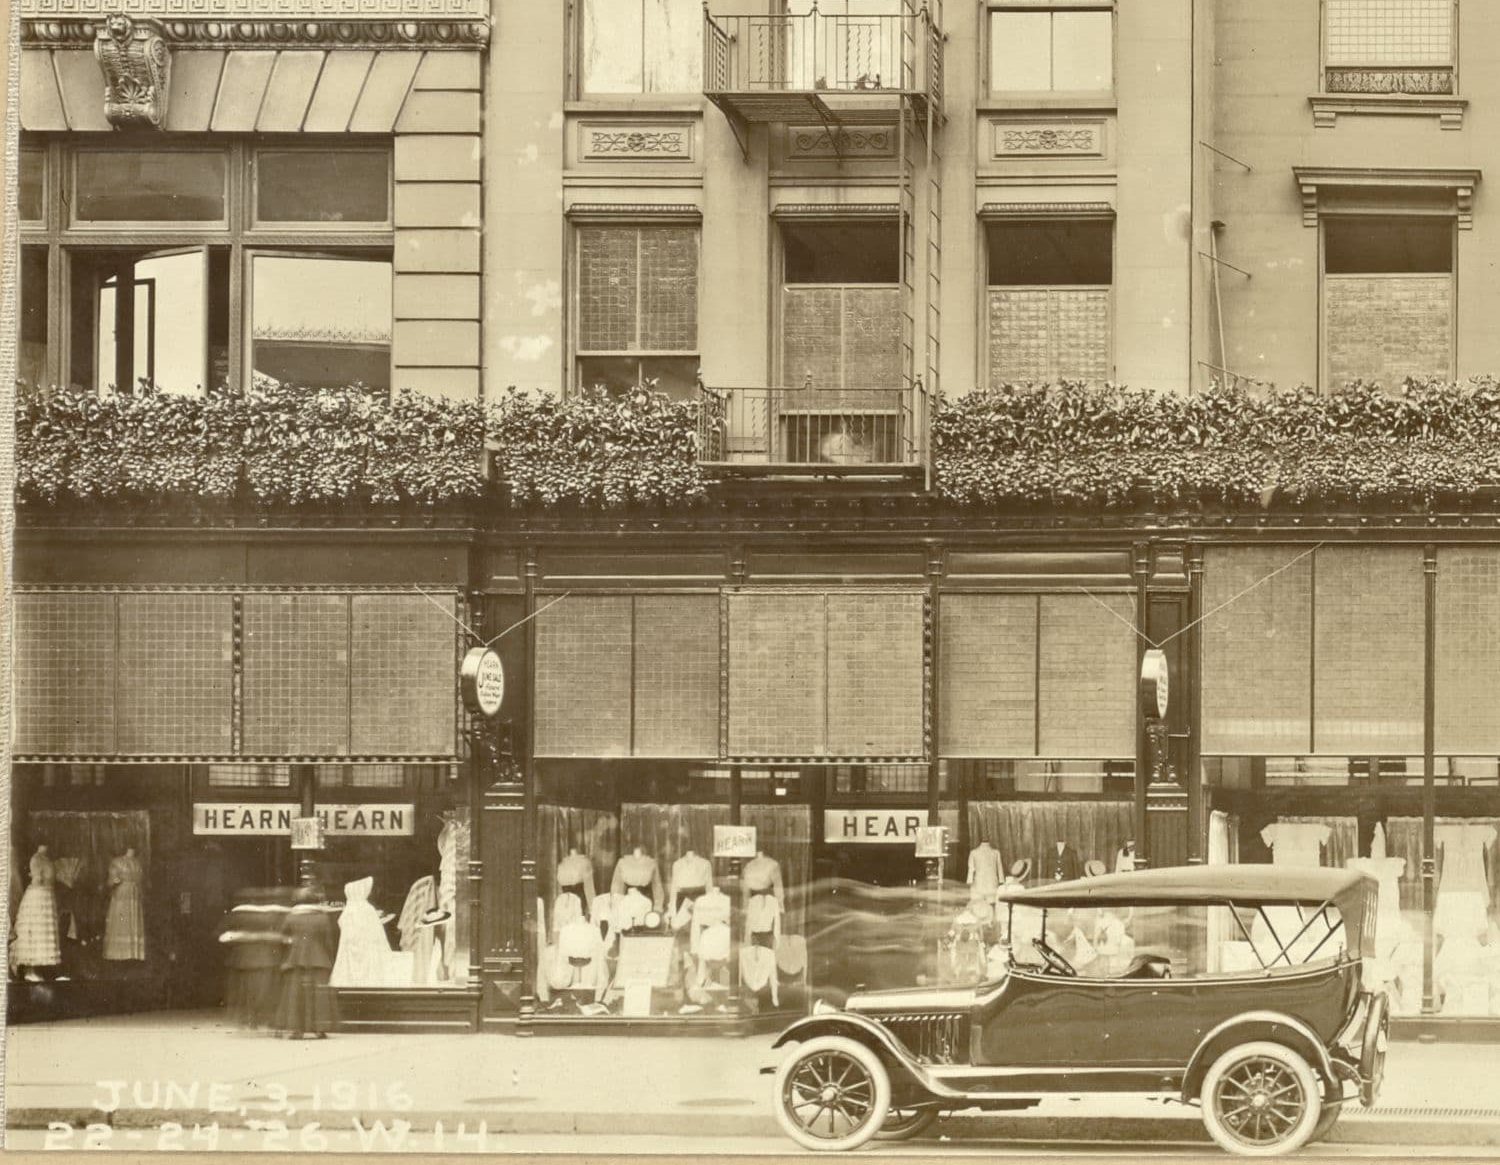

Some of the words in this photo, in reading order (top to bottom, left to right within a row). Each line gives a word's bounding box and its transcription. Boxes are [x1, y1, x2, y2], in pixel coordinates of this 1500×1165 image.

[205, 809, 291, 829] HEARN
[317, 810, 403, 830] HEARN
[843, 816, 921, 837] HEAR
